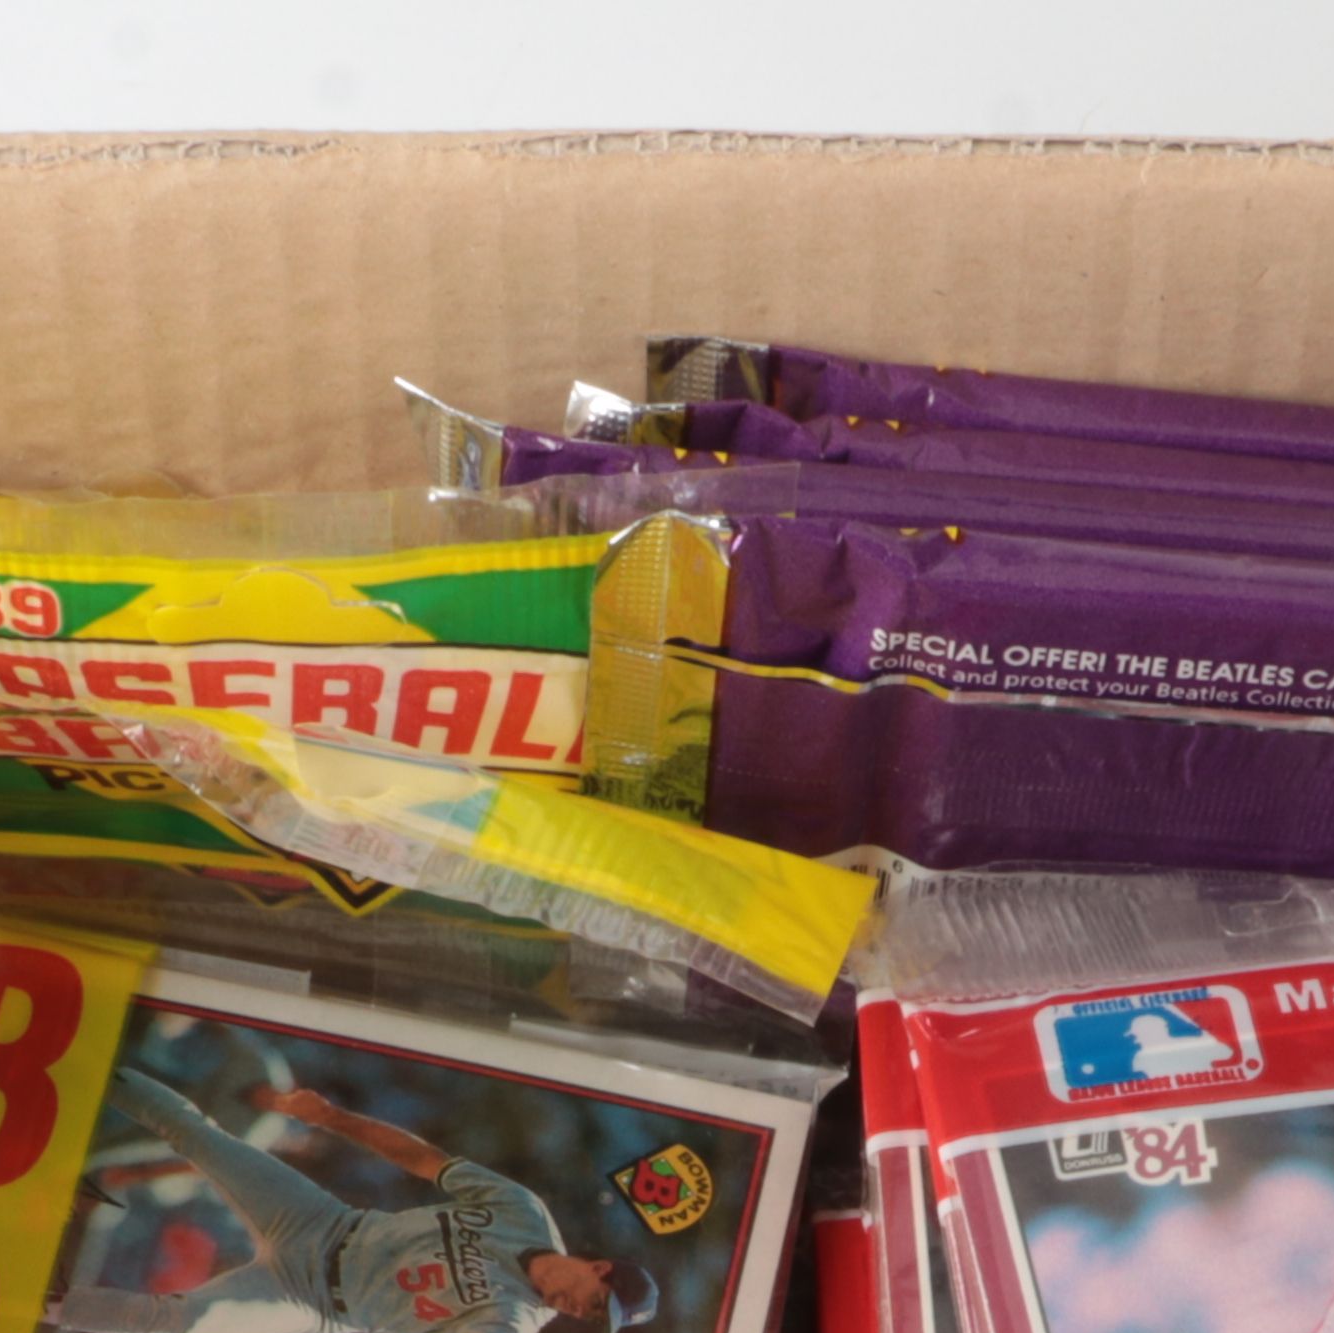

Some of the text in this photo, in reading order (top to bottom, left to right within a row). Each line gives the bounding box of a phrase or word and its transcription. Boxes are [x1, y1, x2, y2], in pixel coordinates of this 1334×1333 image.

[869, 653, 946, 679] Collect
[952, 667, 997, 687] and
[1003, 671, 1089, 694] protect
[1095, 680, 1147, 701] your
[1156, 682, 1240, 704] Beatles
[870, 628, 994, 665] SPECIAL
[1003, 645, 1106, 672] OFFER!
[1116, 654, 1168, 678] THE
[1177, 659, 1294, 687] BEATLES
[659, 1151, 710, 1227] BOWMAN
[1063, 1152, 1124, 1172] DONRUSS
[395, 1262, 456, 1323] 54
